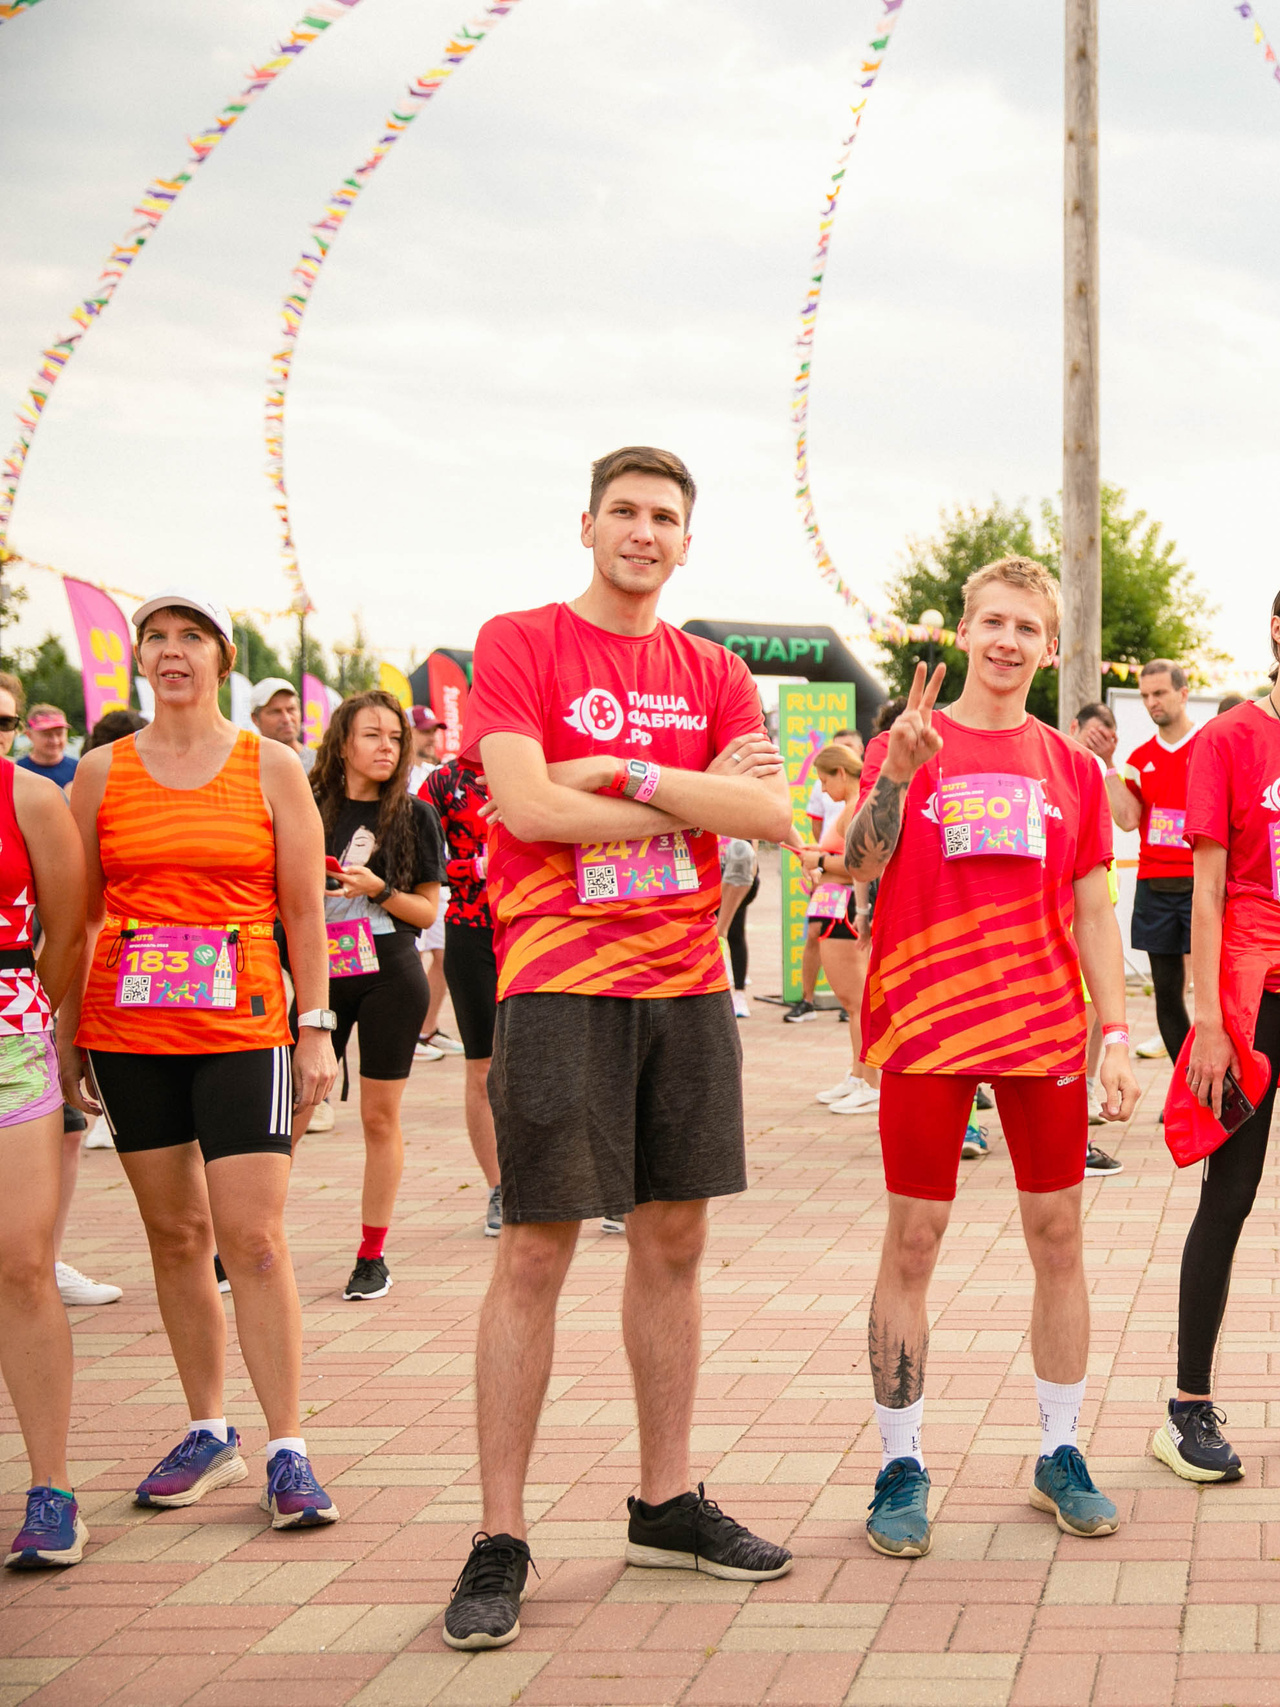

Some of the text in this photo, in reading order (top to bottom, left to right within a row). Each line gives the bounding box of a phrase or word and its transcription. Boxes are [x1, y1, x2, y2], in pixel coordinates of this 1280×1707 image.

[723, 634, 829, 664] СТАРТ
[627, 691, 690, 711] ПИЦЦА
[786, 693, 848, 711] RUN
[942, 796, 1011, 824] 250
[1151, 818, 1174, 832] 101
[580, 836, 654, 864] 247
[126, 950, 190, 973] 183
